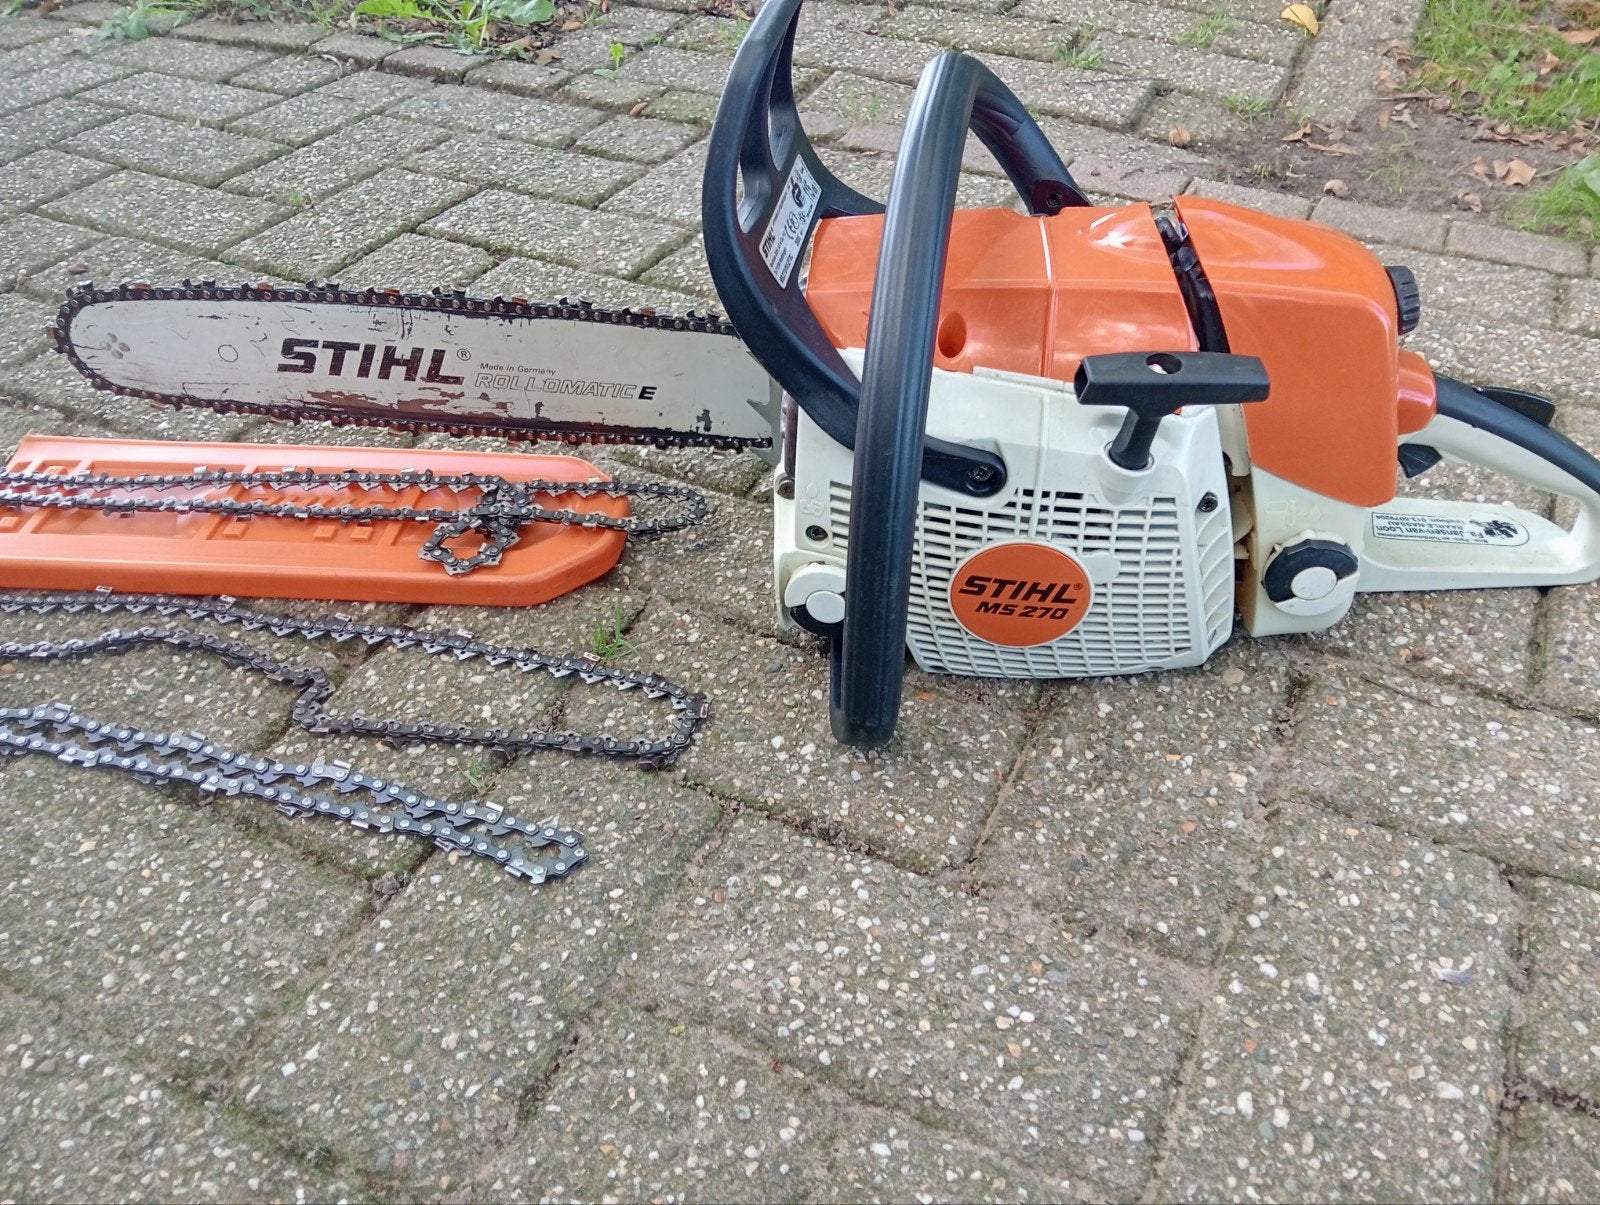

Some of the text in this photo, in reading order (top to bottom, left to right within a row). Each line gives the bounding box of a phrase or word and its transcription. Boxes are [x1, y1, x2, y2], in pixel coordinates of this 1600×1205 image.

[277, 338, 465, 385] STIHL
[480, 362, 557, 376] Made in Germany
[474, 373, 657, 400] ROLLOMATIC E
[1375, 525, 1484, 538] Fa. Jansen-van Loon
[959, 575, 1077, 604] STIHL
[975, 601, 1070, 620] MS 270
